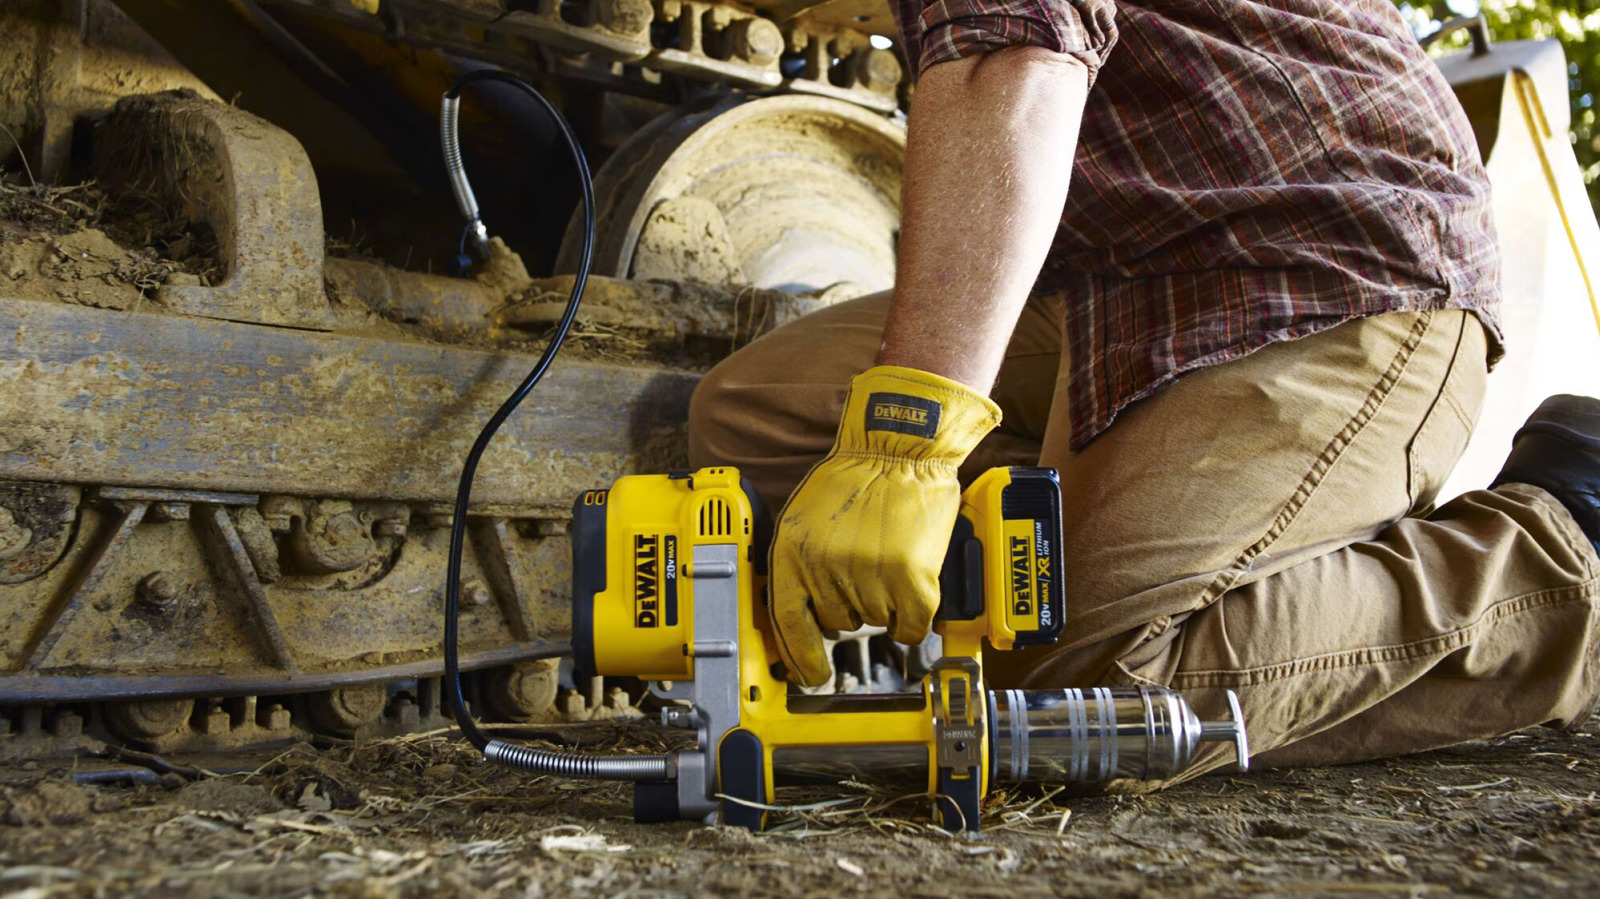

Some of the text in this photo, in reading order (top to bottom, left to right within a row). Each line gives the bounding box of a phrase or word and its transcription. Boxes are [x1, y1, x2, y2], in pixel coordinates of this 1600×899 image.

[874, 404, 928, 424] DEWALT
[667, 540, 675, 559] MAX
[1011, 536, 1031, 616] DEWALT
[1037, 556, 1051, 577] XR
[636, 534, 657, 629] DEWALT
[1041, 582, 1050, 603] MAX
